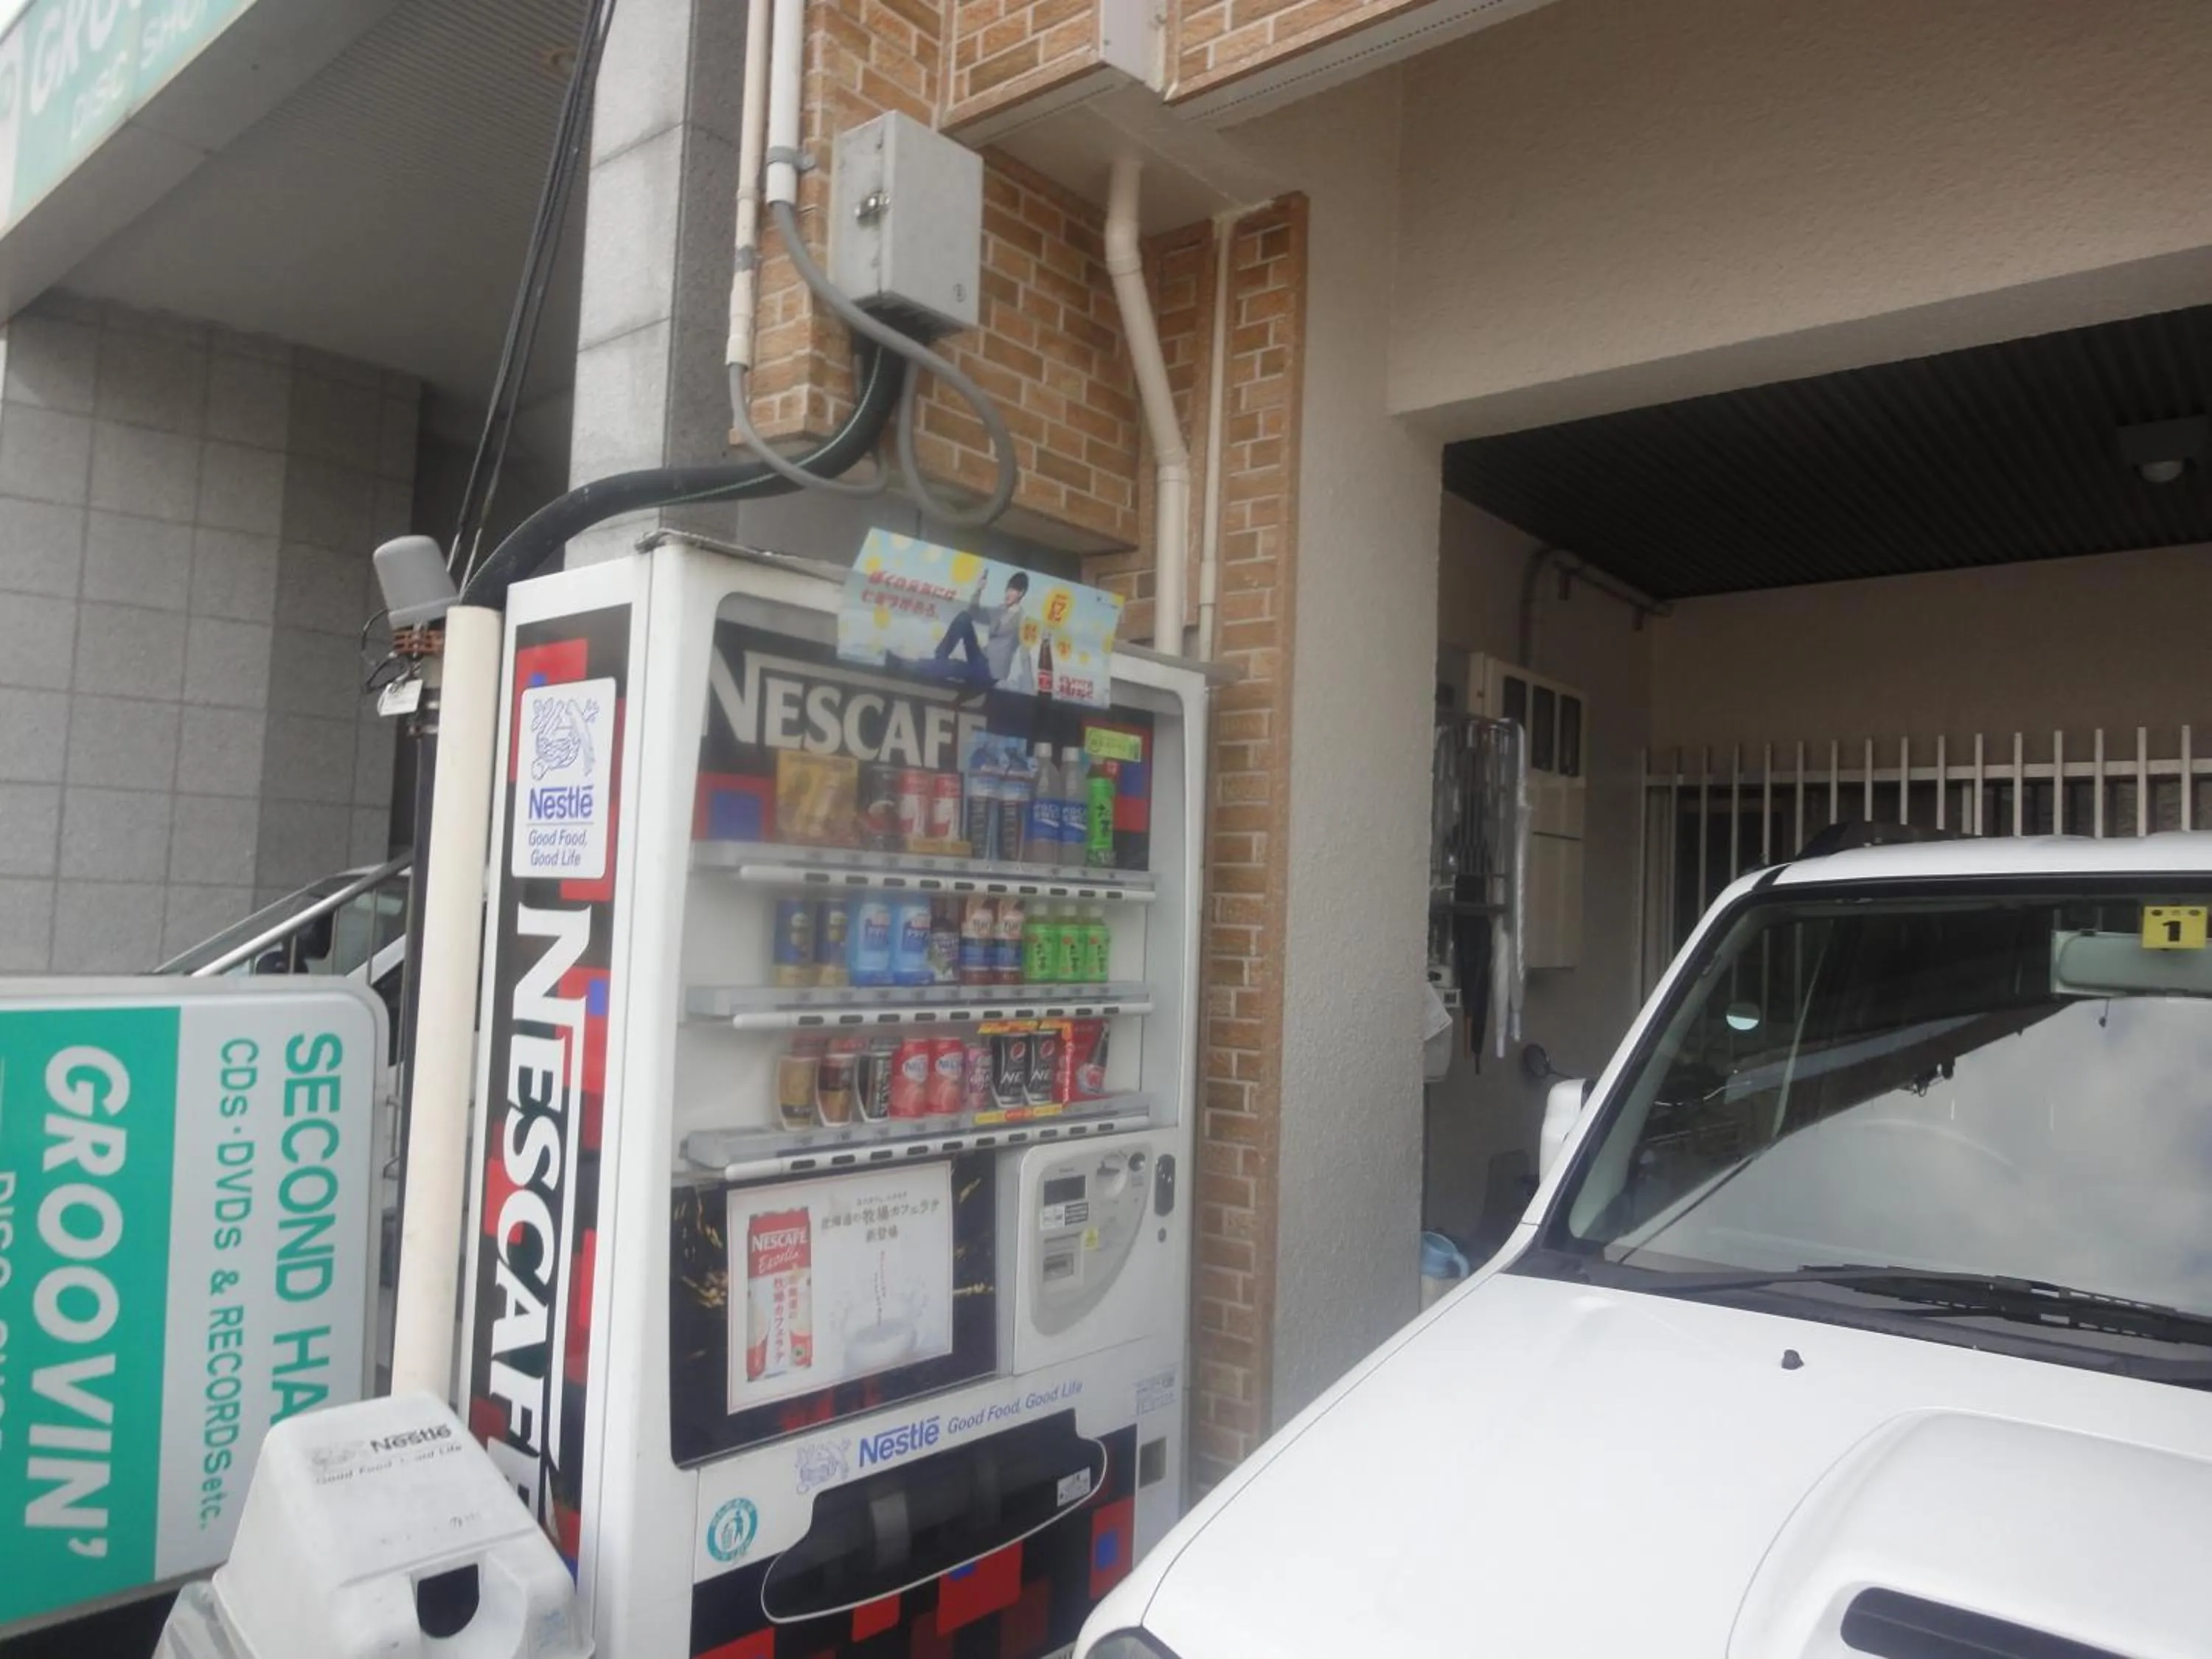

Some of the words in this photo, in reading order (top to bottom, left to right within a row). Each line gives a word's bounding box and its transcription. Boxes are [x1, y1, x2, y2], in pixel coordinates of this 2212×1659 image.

[529, 830, 556, 846] Good
[531, 850, 558, 866] Good
[561, 850, 581, 866] Life
[2162, 920, 2181, 942] 1
[274, 1033, 343, 1303] SECOND
[209, 1270, 240, 1297] &
[947, 1410, 986, 1434] Good
[1026, 1385, 1060, 1409] Good
[1062, 1380, 1084, 1397] Life
